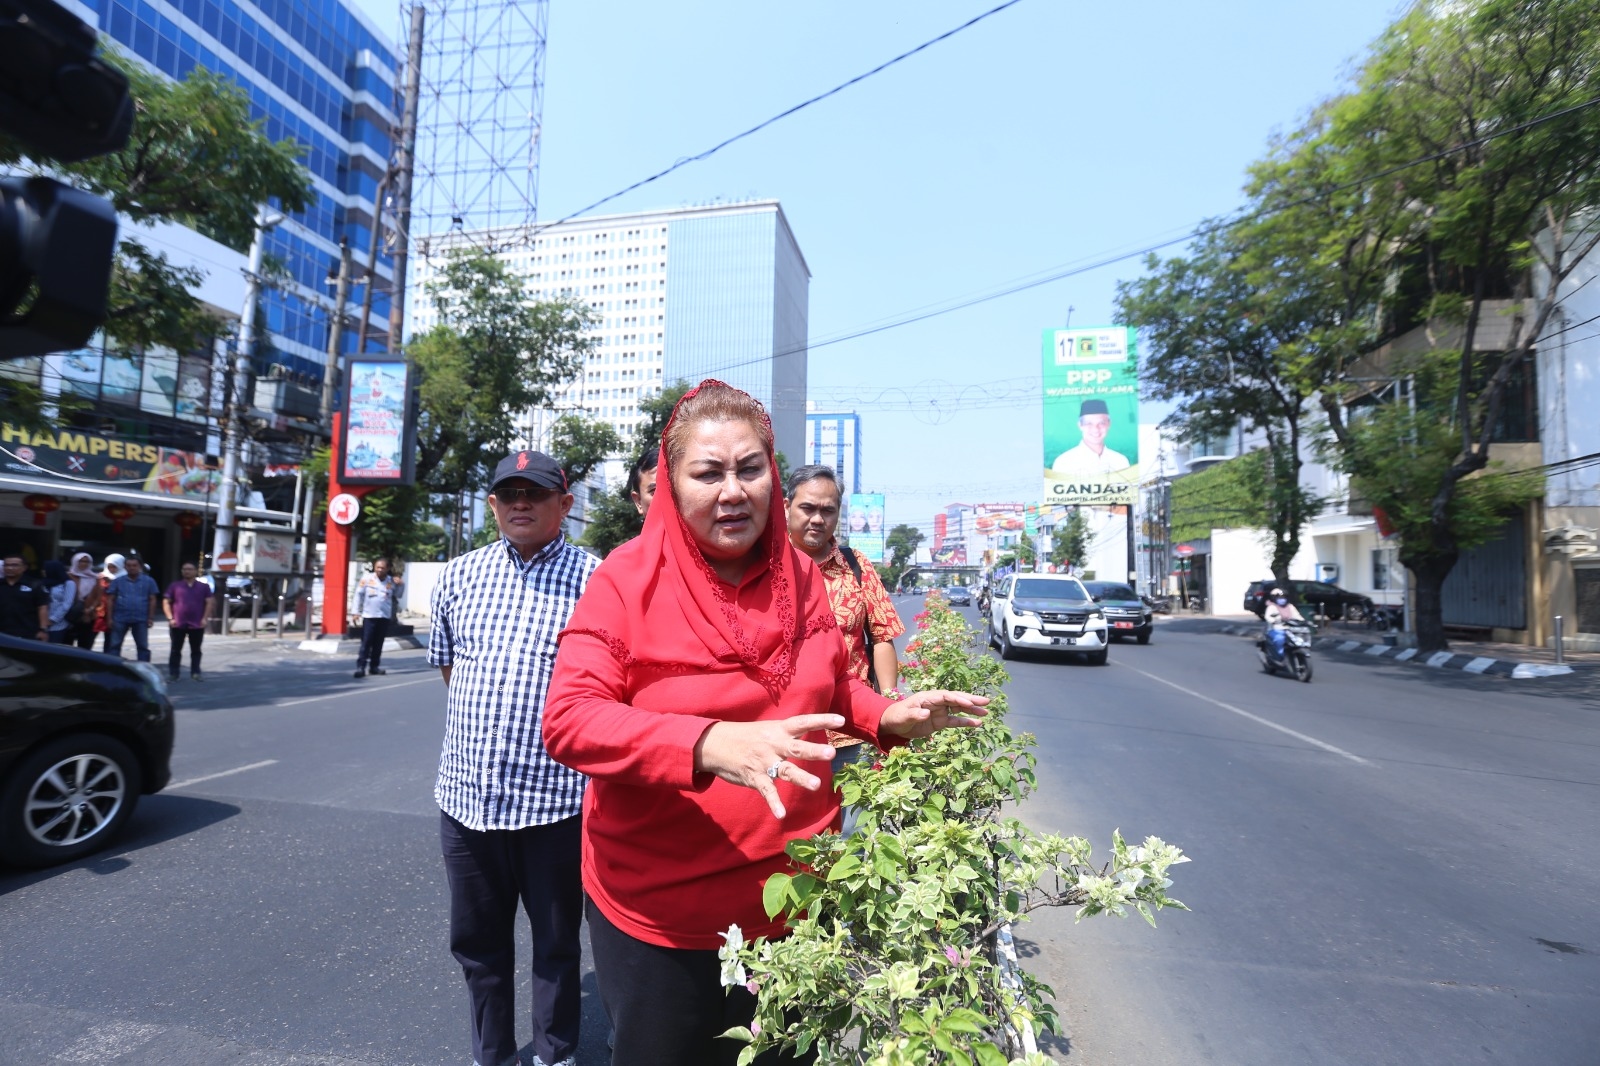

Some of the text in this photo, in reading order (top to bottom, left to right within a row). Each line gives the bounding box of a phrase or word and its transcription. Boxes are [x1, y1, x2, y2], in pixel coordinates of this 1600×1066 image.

[1060, 338, 1074, 357] 17
[1067, 369, 1112, 385] PPP
[1, 422, 157, 464] HAMPERS
[1053, 484, 1129, 495] GANJAR
